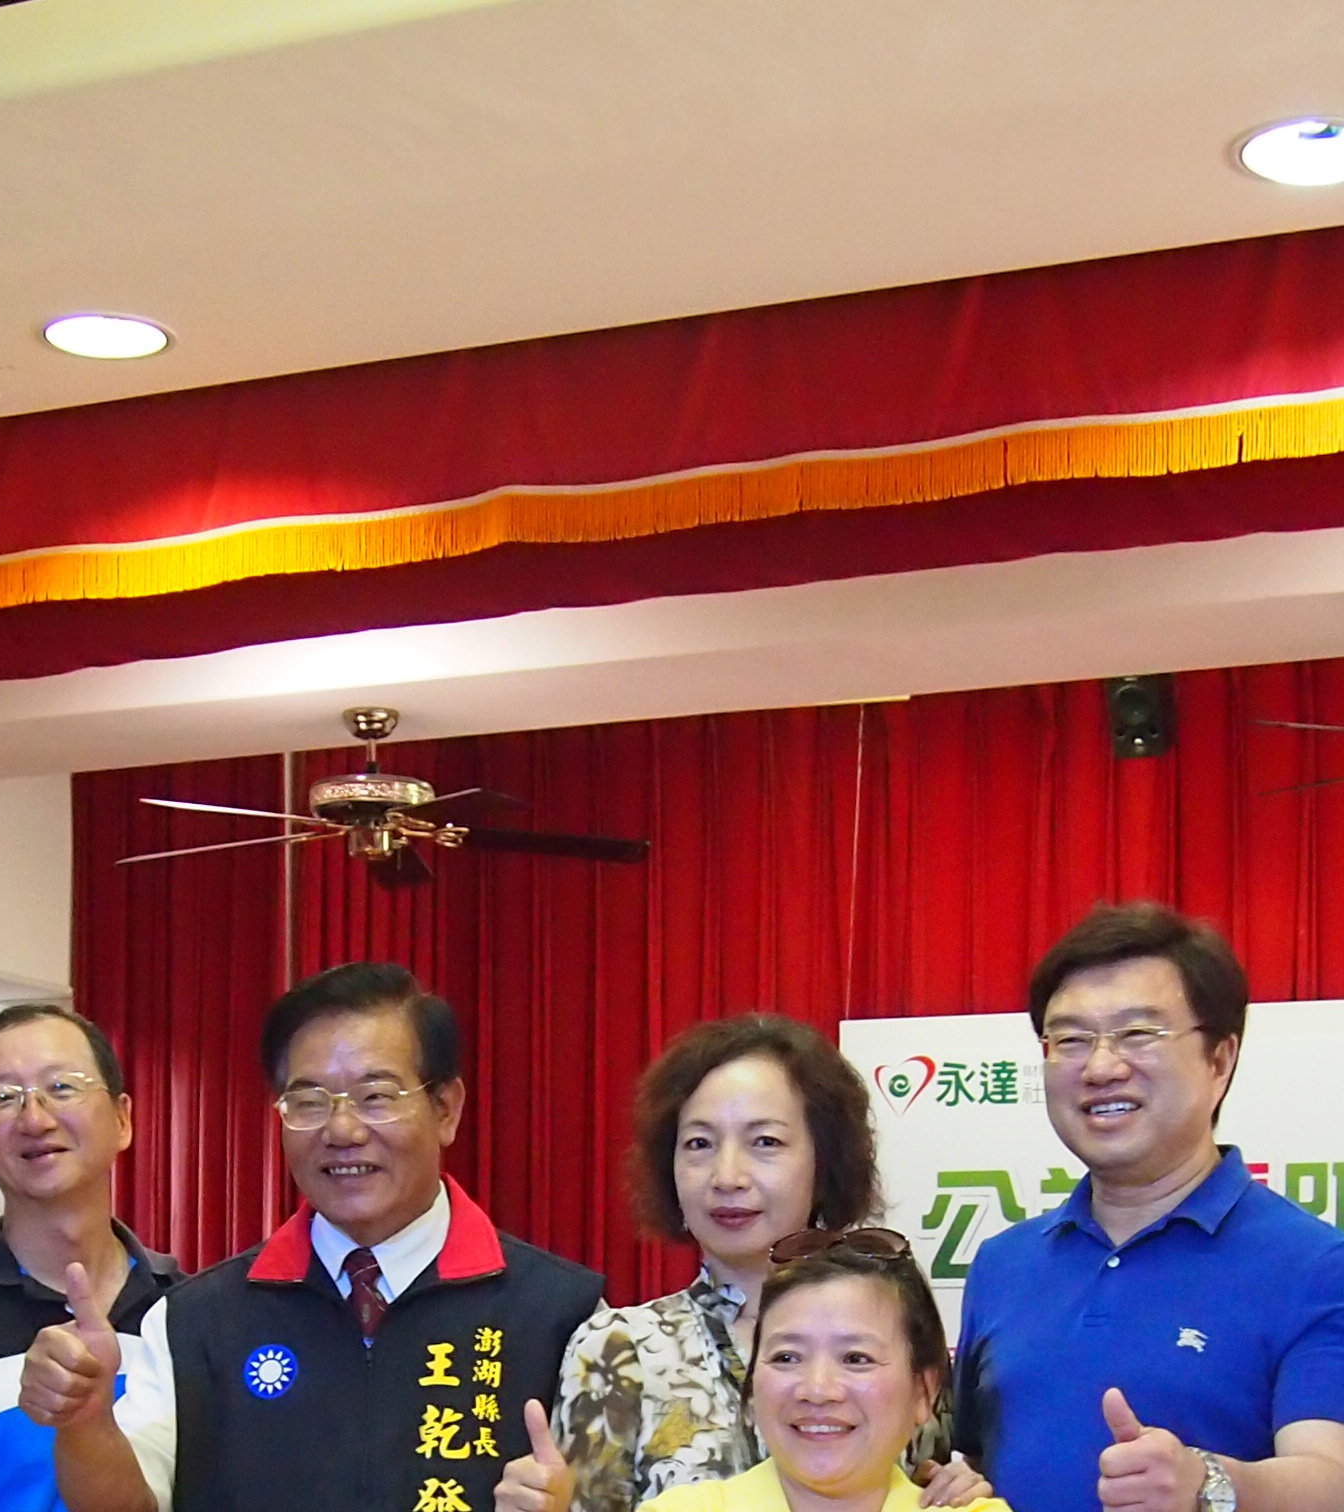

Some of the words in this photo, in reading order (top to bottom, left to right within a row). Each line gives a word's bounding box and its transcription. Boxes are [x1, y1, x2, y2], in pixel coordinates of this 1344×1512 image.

[935, 1060, 1019, 1107] 永達
[471, 1326, 504, 1458] 澎湖縣長
